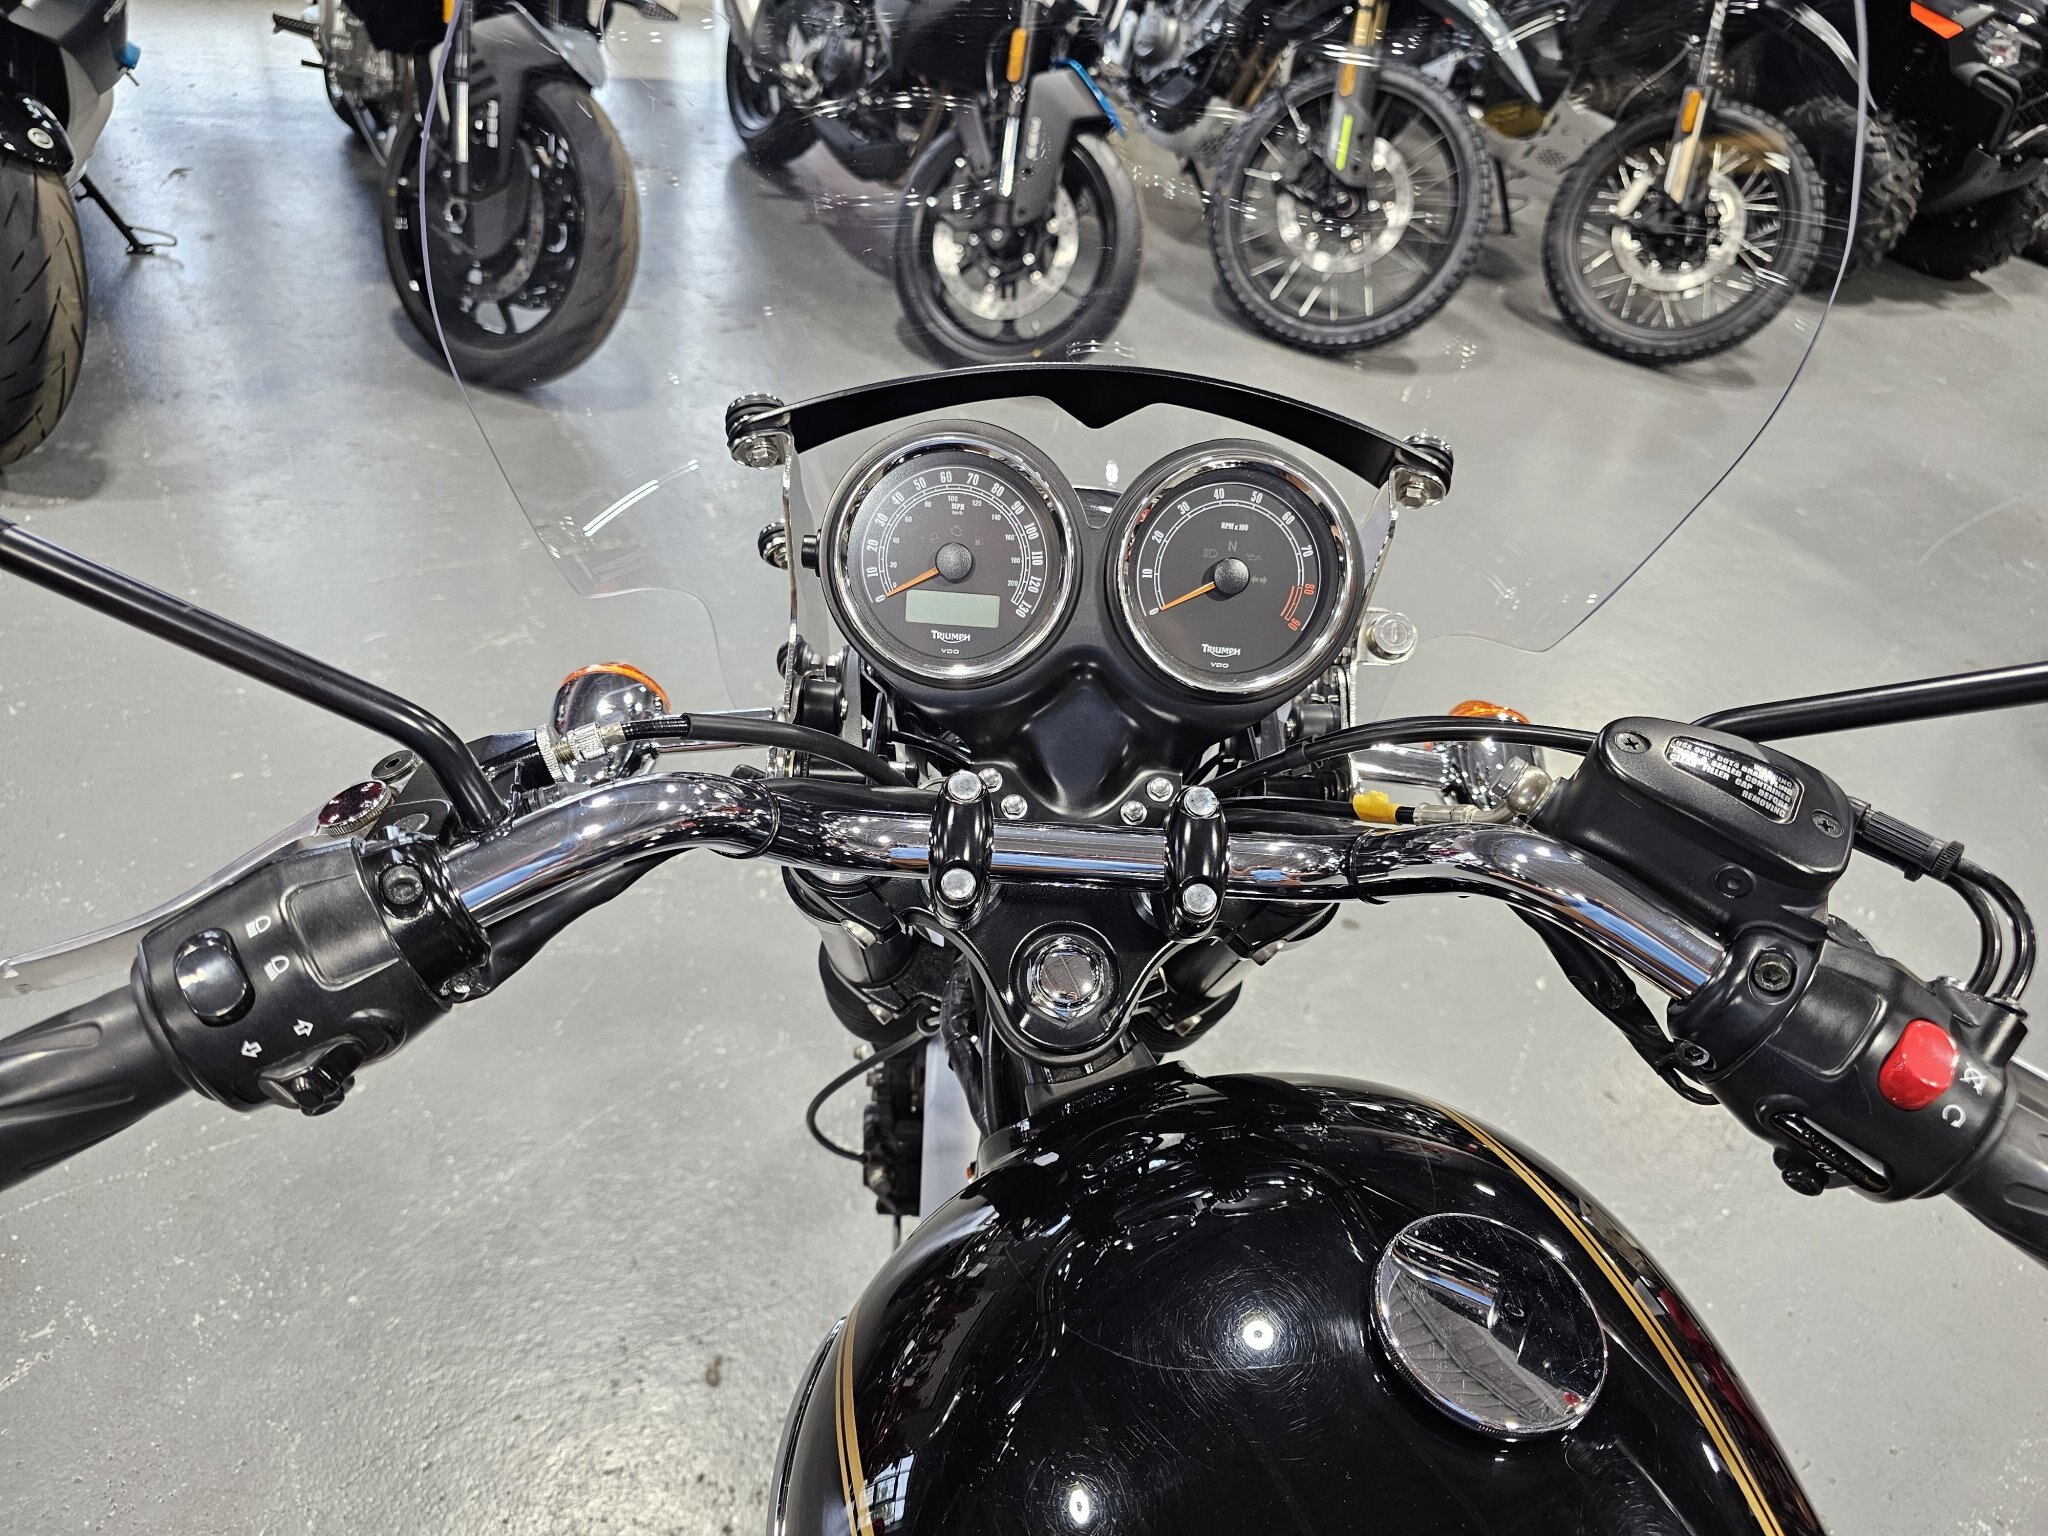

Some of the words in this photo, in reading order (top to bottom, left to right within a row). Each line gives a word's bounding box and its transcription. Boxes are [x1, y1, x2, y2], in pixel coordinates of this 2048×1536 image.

[913, 477, 927, 491] 50
[940, 471, 953, 484] 60
[966, 472, 980, 486] 70
[990, 482, 1005, 497] 80
[1211, 488, 1225, 500] 40
[891, 491, 905, 506] 40
[1250, 490, 1263, 504] 50
[951, 503, 965, 511] MPH
[1011, 500, 1025, 516] 90
[1177, 501, 1190, 515] 30
[875, 513, 888, 527] 30
[1281, 511, 1296, 525] 60
[1023, 522, 1040, 541] 100
[1220, 521, 1234, 531] RPM
[1239, 523, 1249, 532] 100
[1151, 530, 1165, 544] 20
[866, 539, 879, 552] 20
[1228, 540, 1238, 552] N
[1301, 544, 1314, 558] 70
[889, 561, 898, 569] 20
[1031, 551, 1044, 566] 110
[866, 566, 879, 578] 10
[1142, 568, 1153, 579] 10
[1027, 575, 1042, 594] 120
[1303, 583, 1315, 595] 80
[875, 594, 886, 603] 0
[1015, 600, 1032, 619] 130
[1149, 607, 1160, 616] 0
[1287, 618, 1301, 631] 90
[930, 629, 971, 644] TRIUMPH
[1201, 643, 1241, 658] TRIUMPH
[1210, 661, 1229, 669] VDO
[1694, 746, 1715, 758] ONLY
[1701, 763, 1730, 781] FILLER
[1735, 778, 1753, 790] CAP
[1758, 788, 1789, 810] BEFORE
[1711, 760, 1742, 777] SEALED
[1745, 774, 1790, 802] CONTAINER
[1741, 789, 1786, 818] REMOVING
